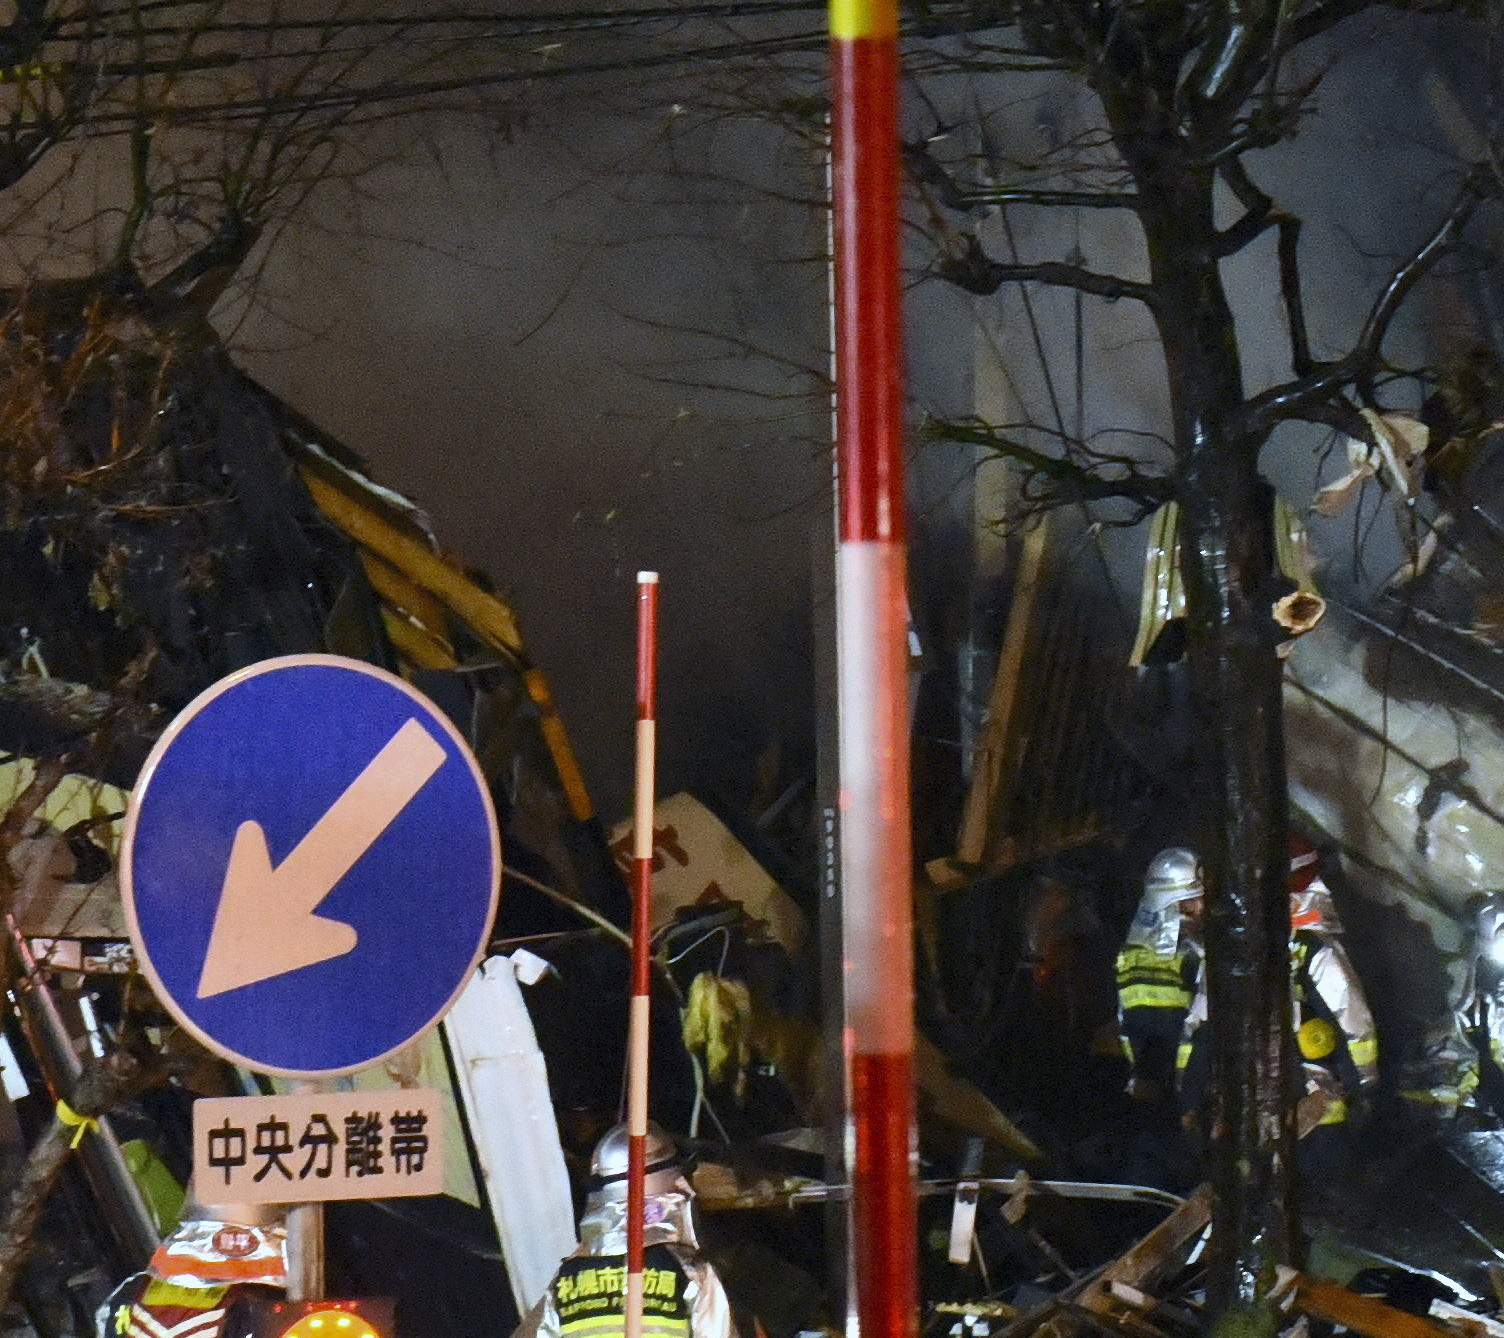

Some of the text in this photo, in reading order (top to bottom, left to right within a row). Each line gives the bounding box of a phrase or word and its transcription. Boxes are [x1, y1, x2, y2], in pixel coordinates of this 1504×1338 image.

[207, 1108, 429, 1186] 中央分離帯
